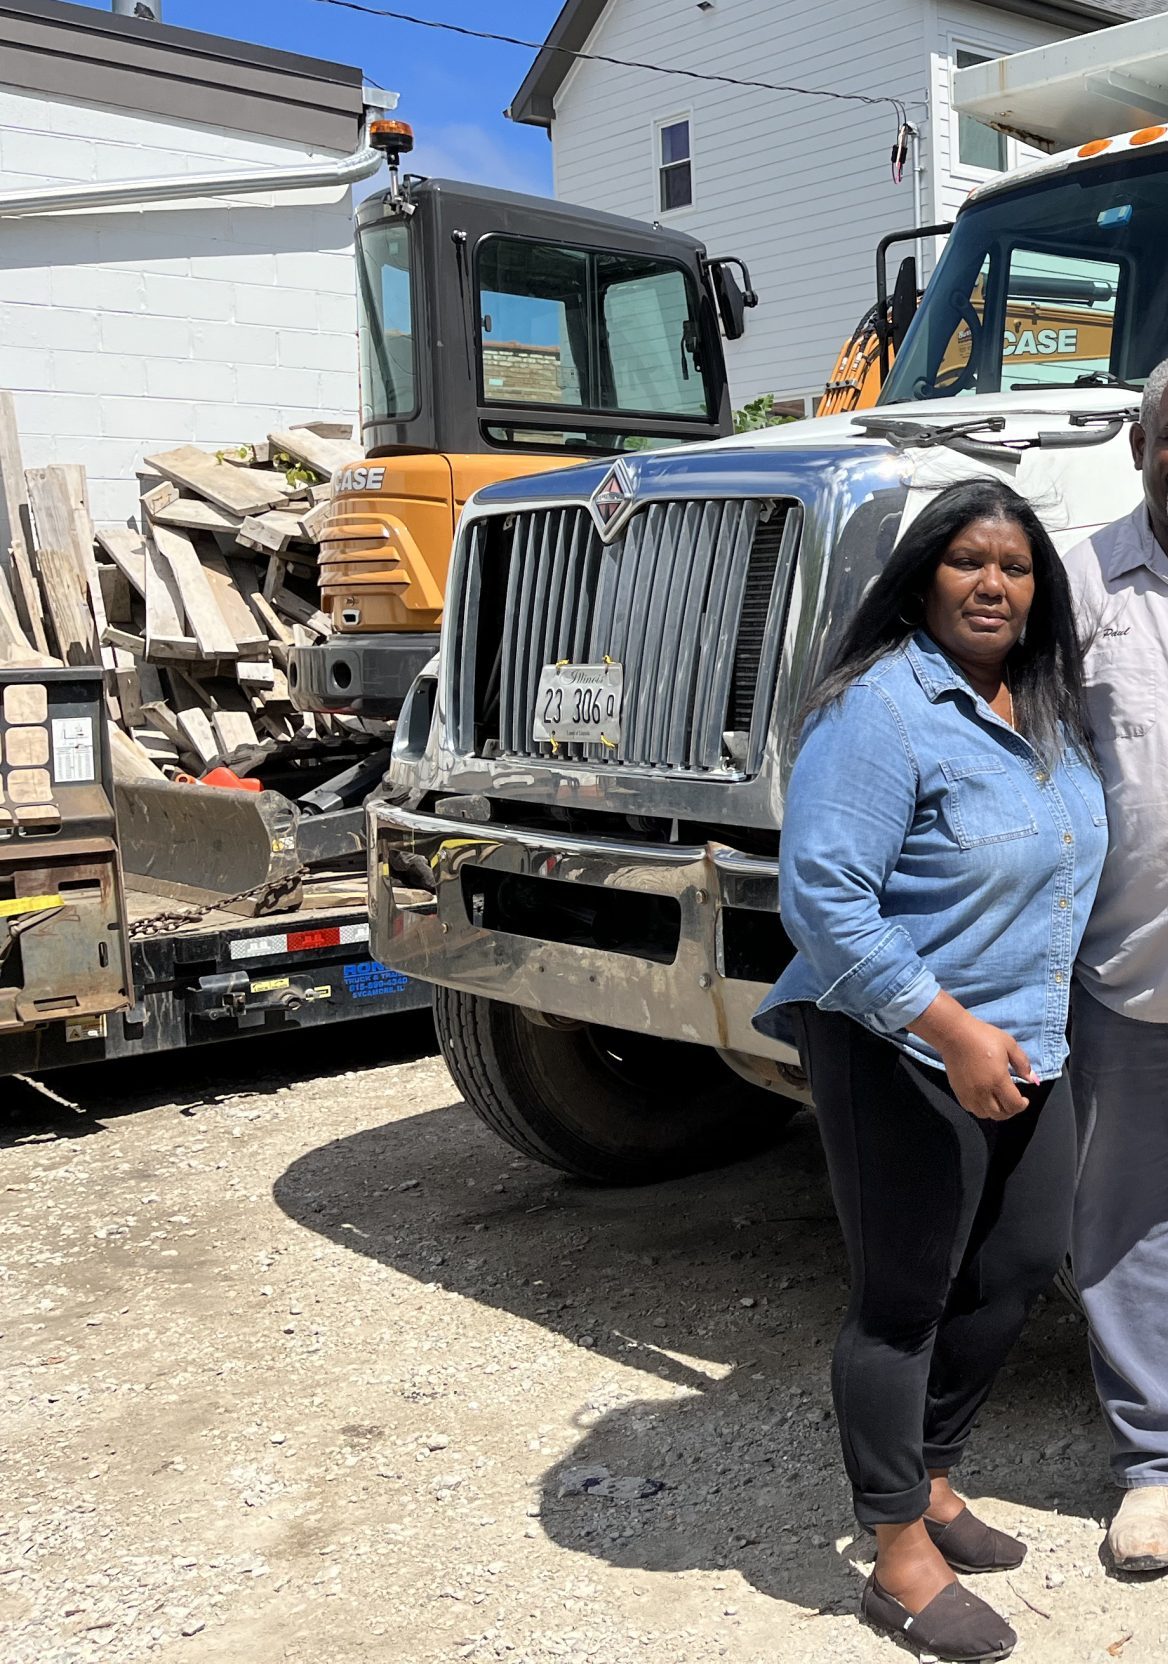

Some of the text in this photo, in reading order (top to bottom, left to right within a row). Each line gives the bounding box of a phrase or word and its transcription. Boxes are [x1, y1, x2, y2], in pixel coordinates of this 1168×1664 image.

[1003, 328, 1078, 356] CASE
[1103, 626, 1131, 639] Paul
[561, 669, 605, 686] Illinois
[543, 688, 563, 724] 23
[573, 688, 602, 725] 306
